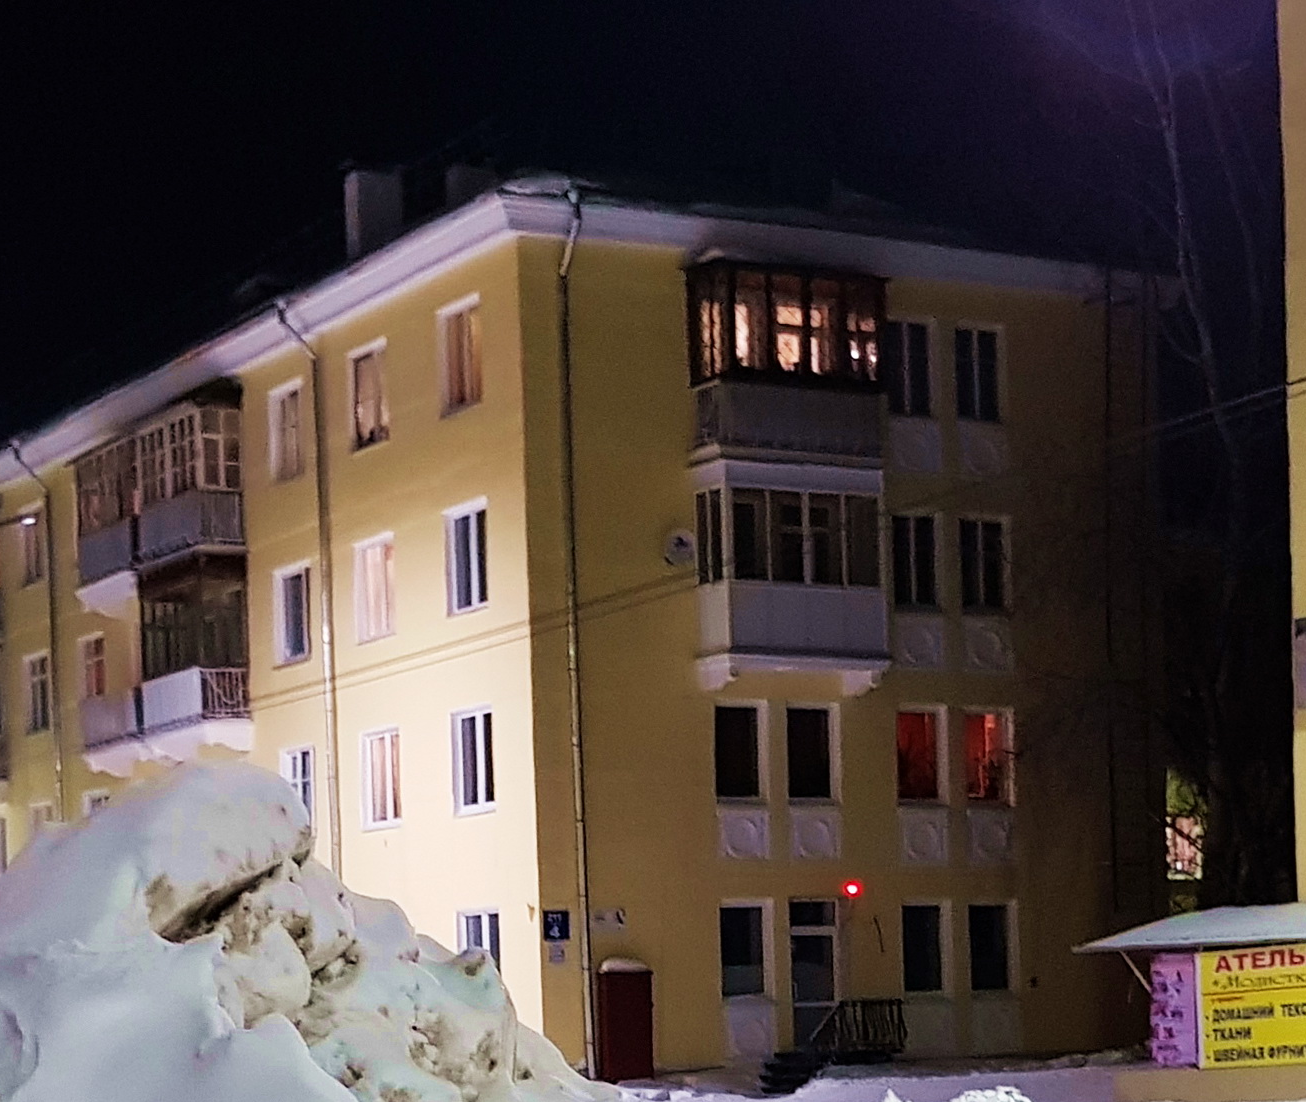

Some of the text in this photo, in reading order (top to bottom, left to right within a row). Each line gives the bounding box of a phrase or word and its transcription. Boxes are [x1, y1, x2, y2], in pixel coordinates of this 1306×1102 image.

[1212, 1003, 1275, 1023] ДОМАШНИЙ
[1212, 1027, 1253, 1041] ТКАНИ
[1213, 1046, 1265, 1062] ШВЕЙНАЯ
